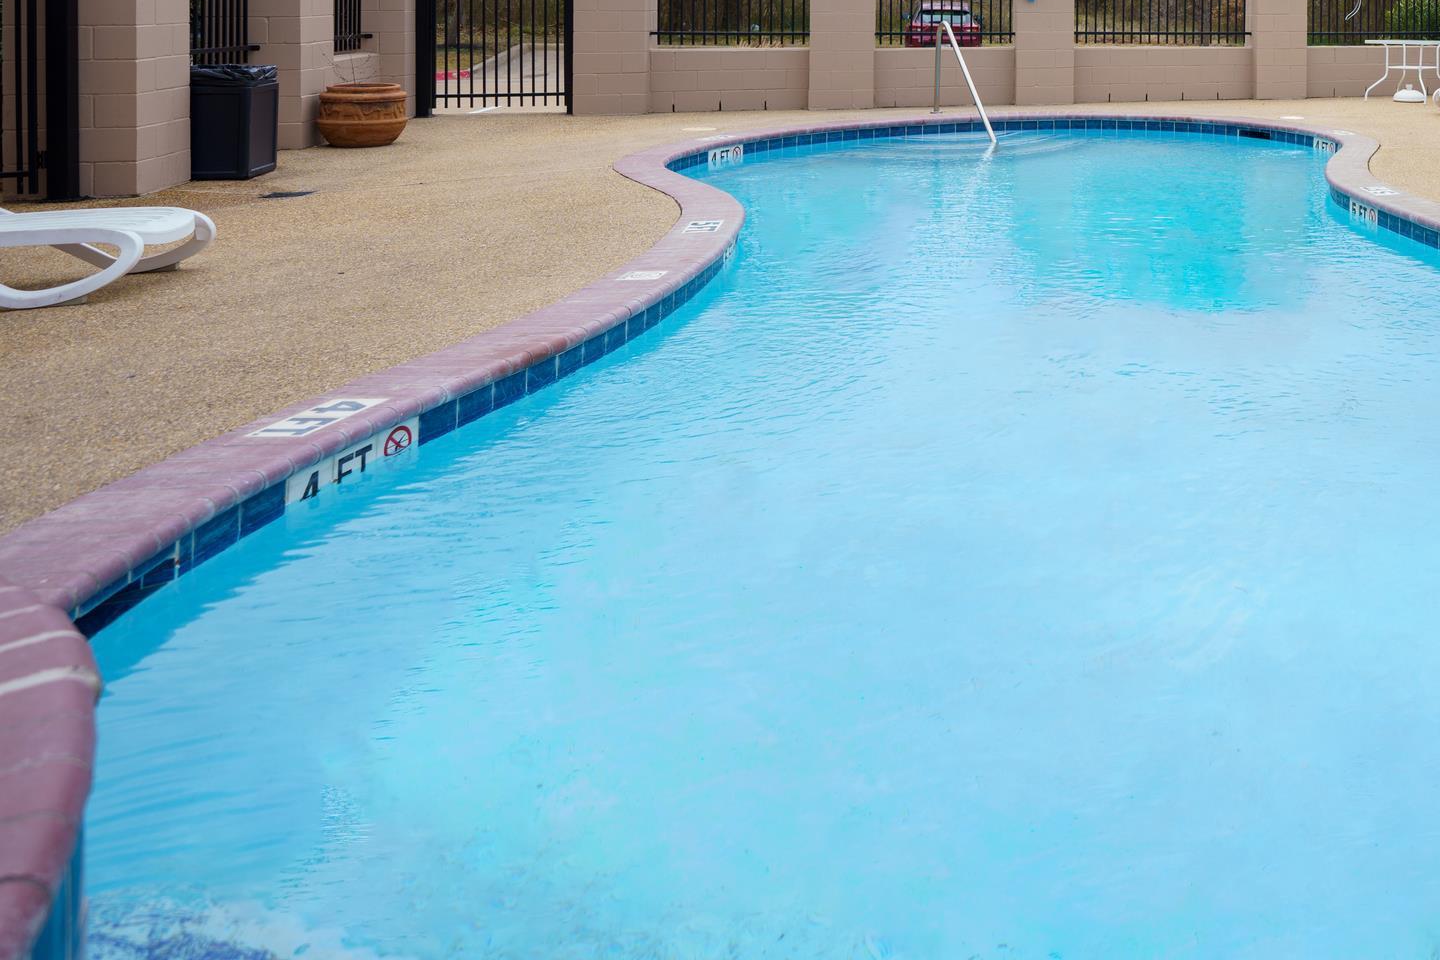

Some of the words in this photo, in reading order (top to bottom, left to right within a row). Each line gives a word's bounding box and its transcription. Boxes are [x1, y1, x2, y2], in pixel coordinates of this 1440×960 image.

[1351, 201, 1357, 215] 5
[1358, 203, 1368, 219] FT
[310, 400, 368, 414] 4
[299, 470, 321, 503] 4
[337, 443, 374, 485] FT
